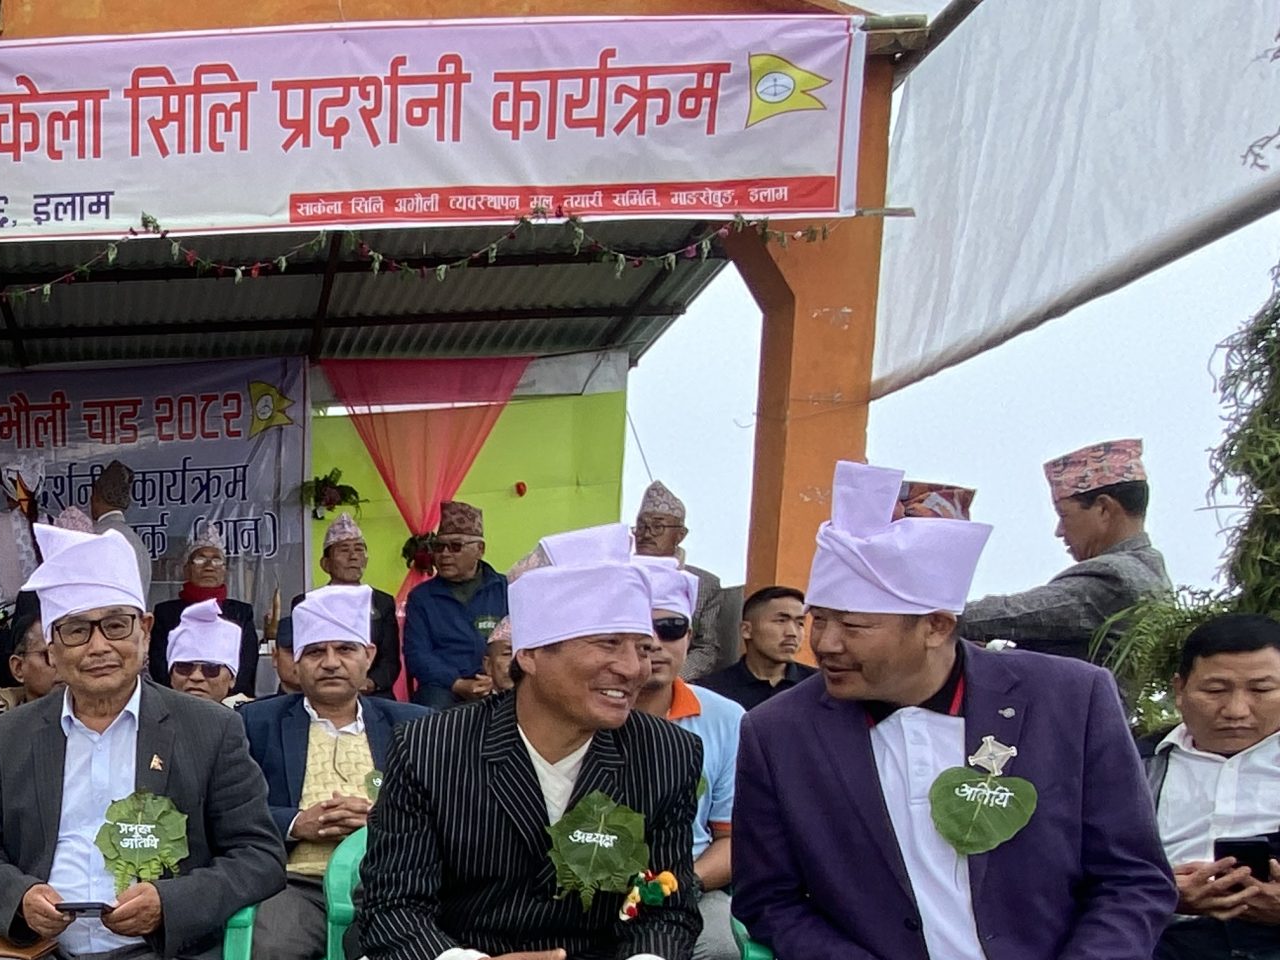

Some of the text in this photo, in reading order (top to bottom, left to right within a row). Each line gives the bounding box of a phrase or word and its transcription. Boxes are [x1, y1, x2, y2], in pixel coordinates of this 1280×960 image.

[123, 63, 258, 159] सिलि
[271, 53, 472, 153] प्रदर्शनी
[492, 47, 732, 141] कार्यक्रम
[32, 190, 116, 226] इलाम
[296, 198, 342, 216] साकेला
[350, 195, 385, 214] सिलि
[563, 190, 603, 209] तयारी
[748, 185, 789, 204] इलाम
[154, 390, 243, 442] २०८२
[131, 456, 250, 509] कार्यक्रम
[954, 782, 1015, 809] अतिथि
